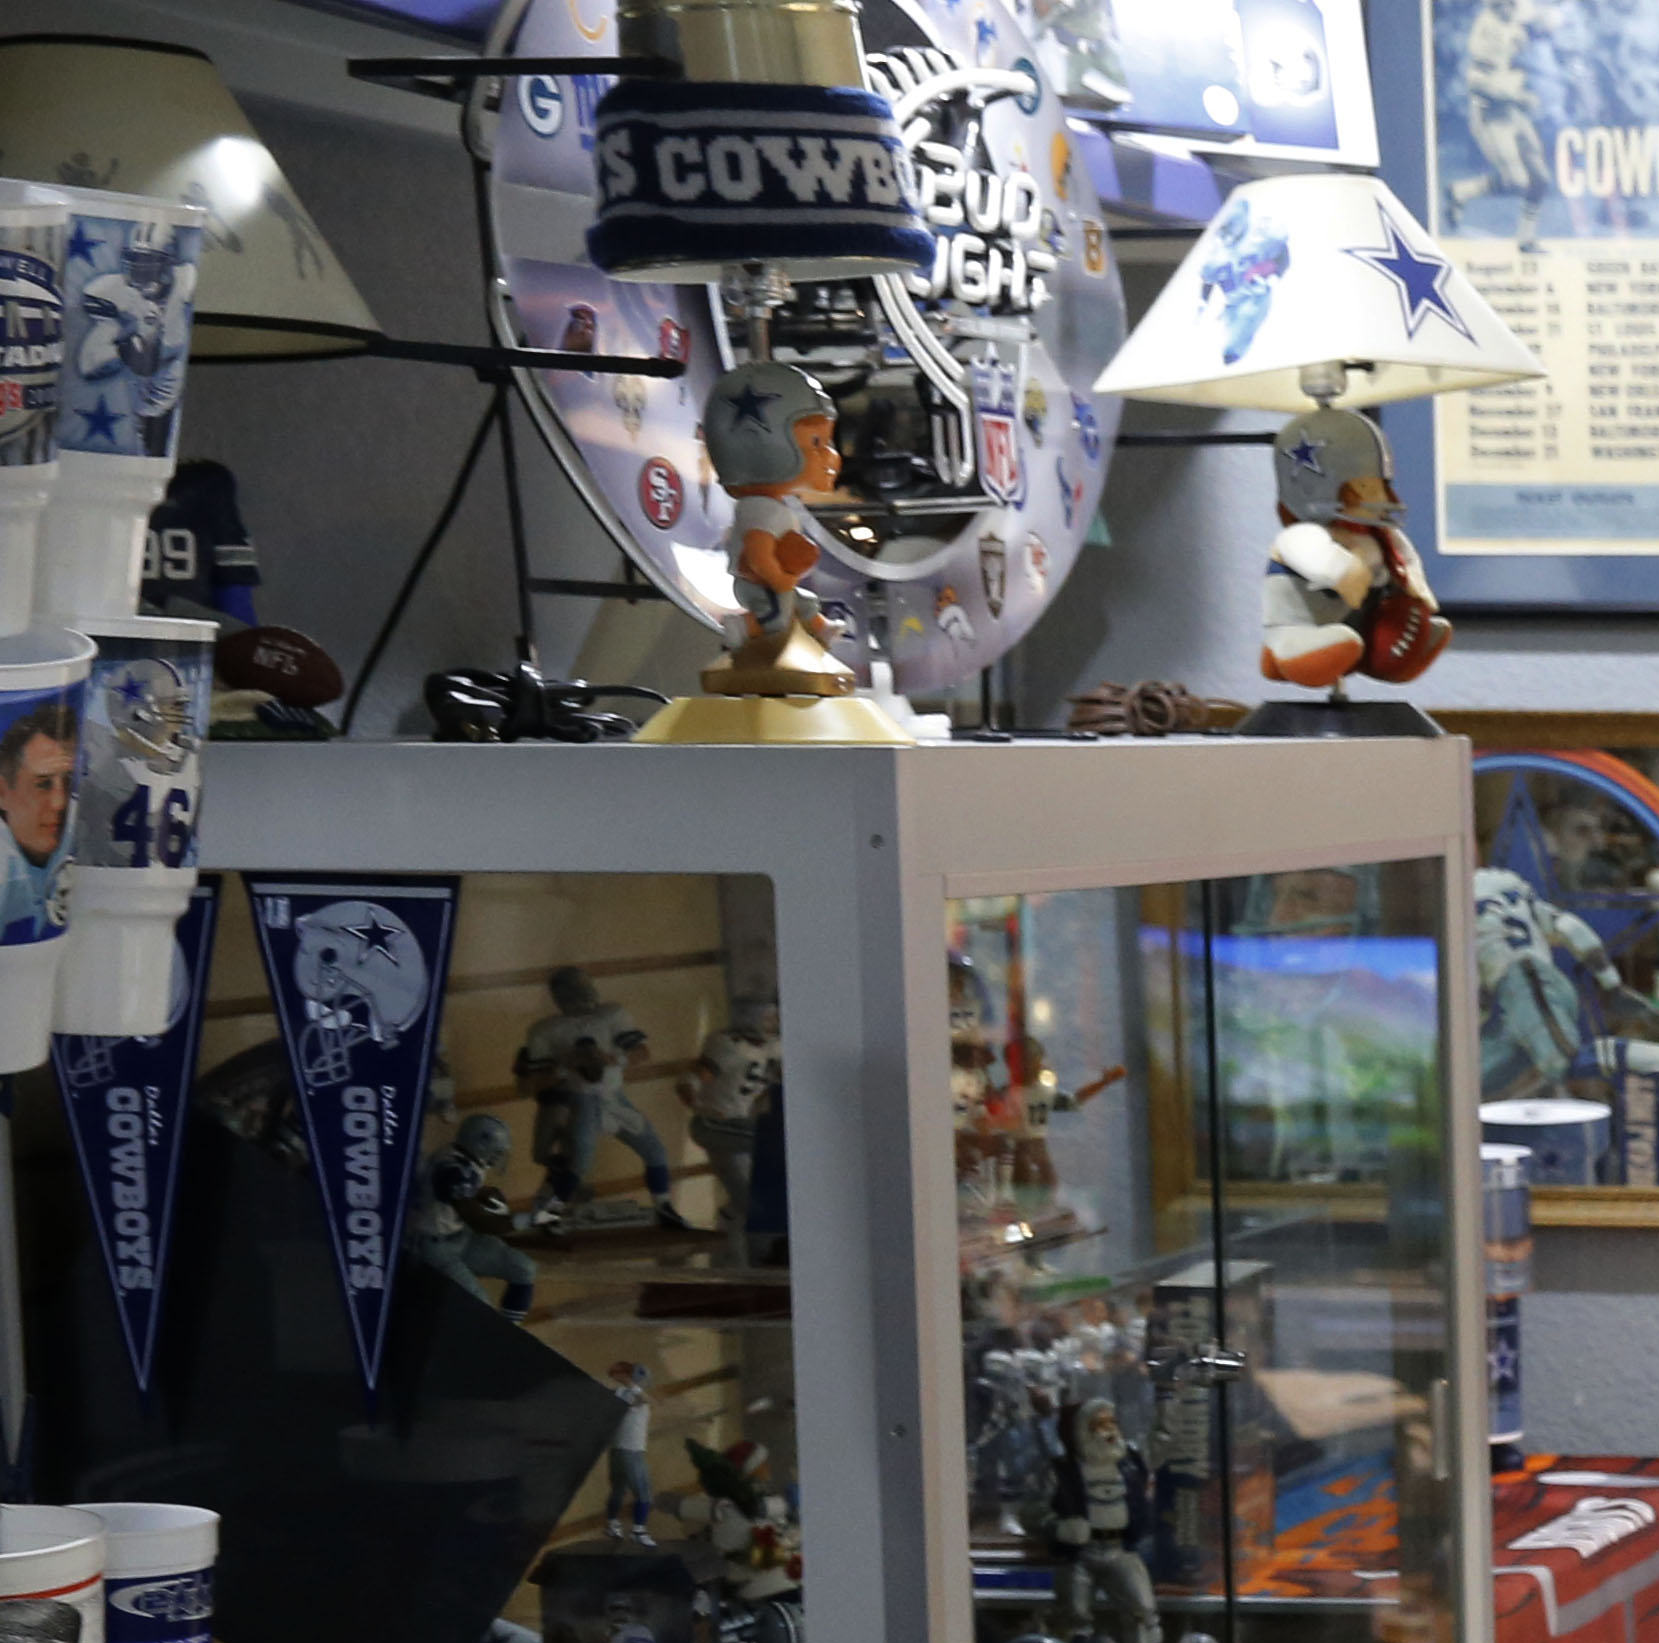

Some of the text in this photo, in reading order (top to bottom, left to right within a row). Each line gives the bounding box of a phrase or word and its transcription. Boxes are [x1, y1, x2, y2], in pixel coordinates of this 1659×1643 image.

[919, 141, 1041, 242] BUD
[113, 782, 192, 869] 46
[105, 1086, 154, 1290] COWBOYS
[341, 1086, 387, 1290] COWBOYS
